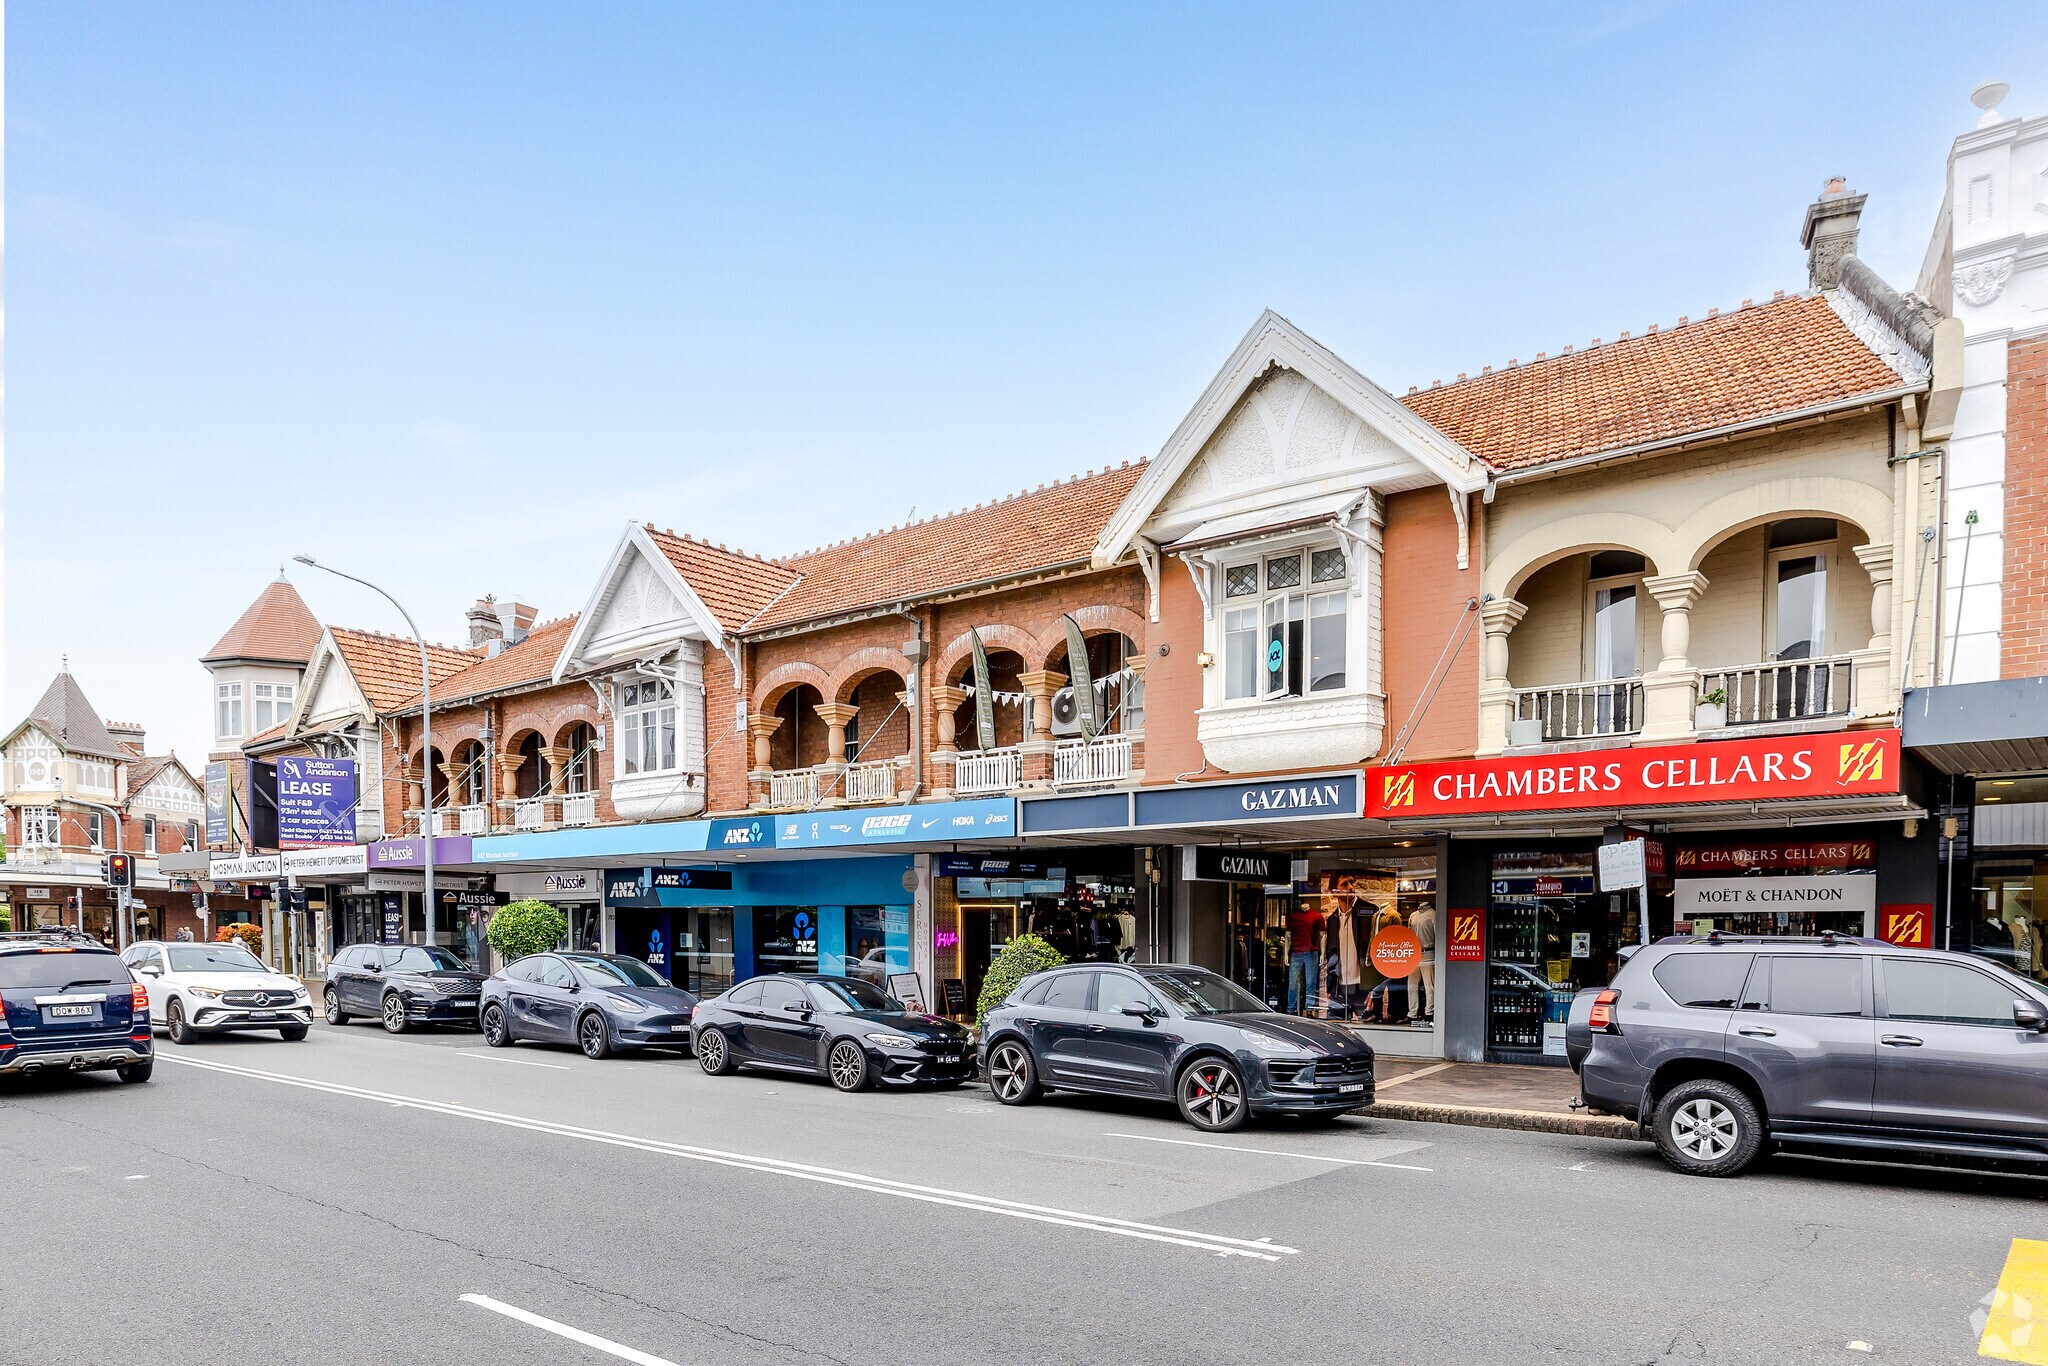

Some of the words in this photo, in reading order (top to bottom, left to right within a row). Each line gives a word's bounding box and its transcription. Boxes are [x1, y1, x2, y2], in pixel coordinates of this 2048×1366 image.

[305, 760, 334, 769] Sutton
[305, 768, 348, 777] Anderson
[1433, 763, 1621, 801] CHAMBERS
[1642, 751, 1812, 789] CELLARS
[281, 781, 332, 796] LEASE
[297, 799, 313, 807] F&B
[1241, 785, 1340, 811] GAZMAN
[301, 808, 322, 816] retail
[302, 818, 329, 826] spaces
[952, 815, 975, 827] HOKA
[723, 828, 750, 844] ANZ
[869, 828, 902, 836] ATHLETIC
[389, 845, 413, 860] Aussie
[1701, 849, 1777, 862] CHAMBERS
[1784, 847, 1847, 859] CELLARS
[213, 863, 243, 875] MOSMAN
[244, 860, 277, 873] JUNCTION
[290, 858, 305, 868] PETER
[306, 857, 326, 867] HEWETT
[327, 854, 364, 866] OPTOMETRIST
[1221, 856, 1268, 876] GAZMAN
[557, 874, 586, 890] Aussie
[654, 874, 679, 885] ANZ
[610, 882, 635, 898] ANZ
[1698, 888, 1742, 903] MOËT
[1746, 890, 1756, 901] &
[1760, 888, 1843, 901] CHANDON
[459, 892, 496, 904] Aussie
[647, 953, 664, 964] ANZ
[1376, 949, 1395, 958] 25%
[1396, 949, 1414, 958] OFF
